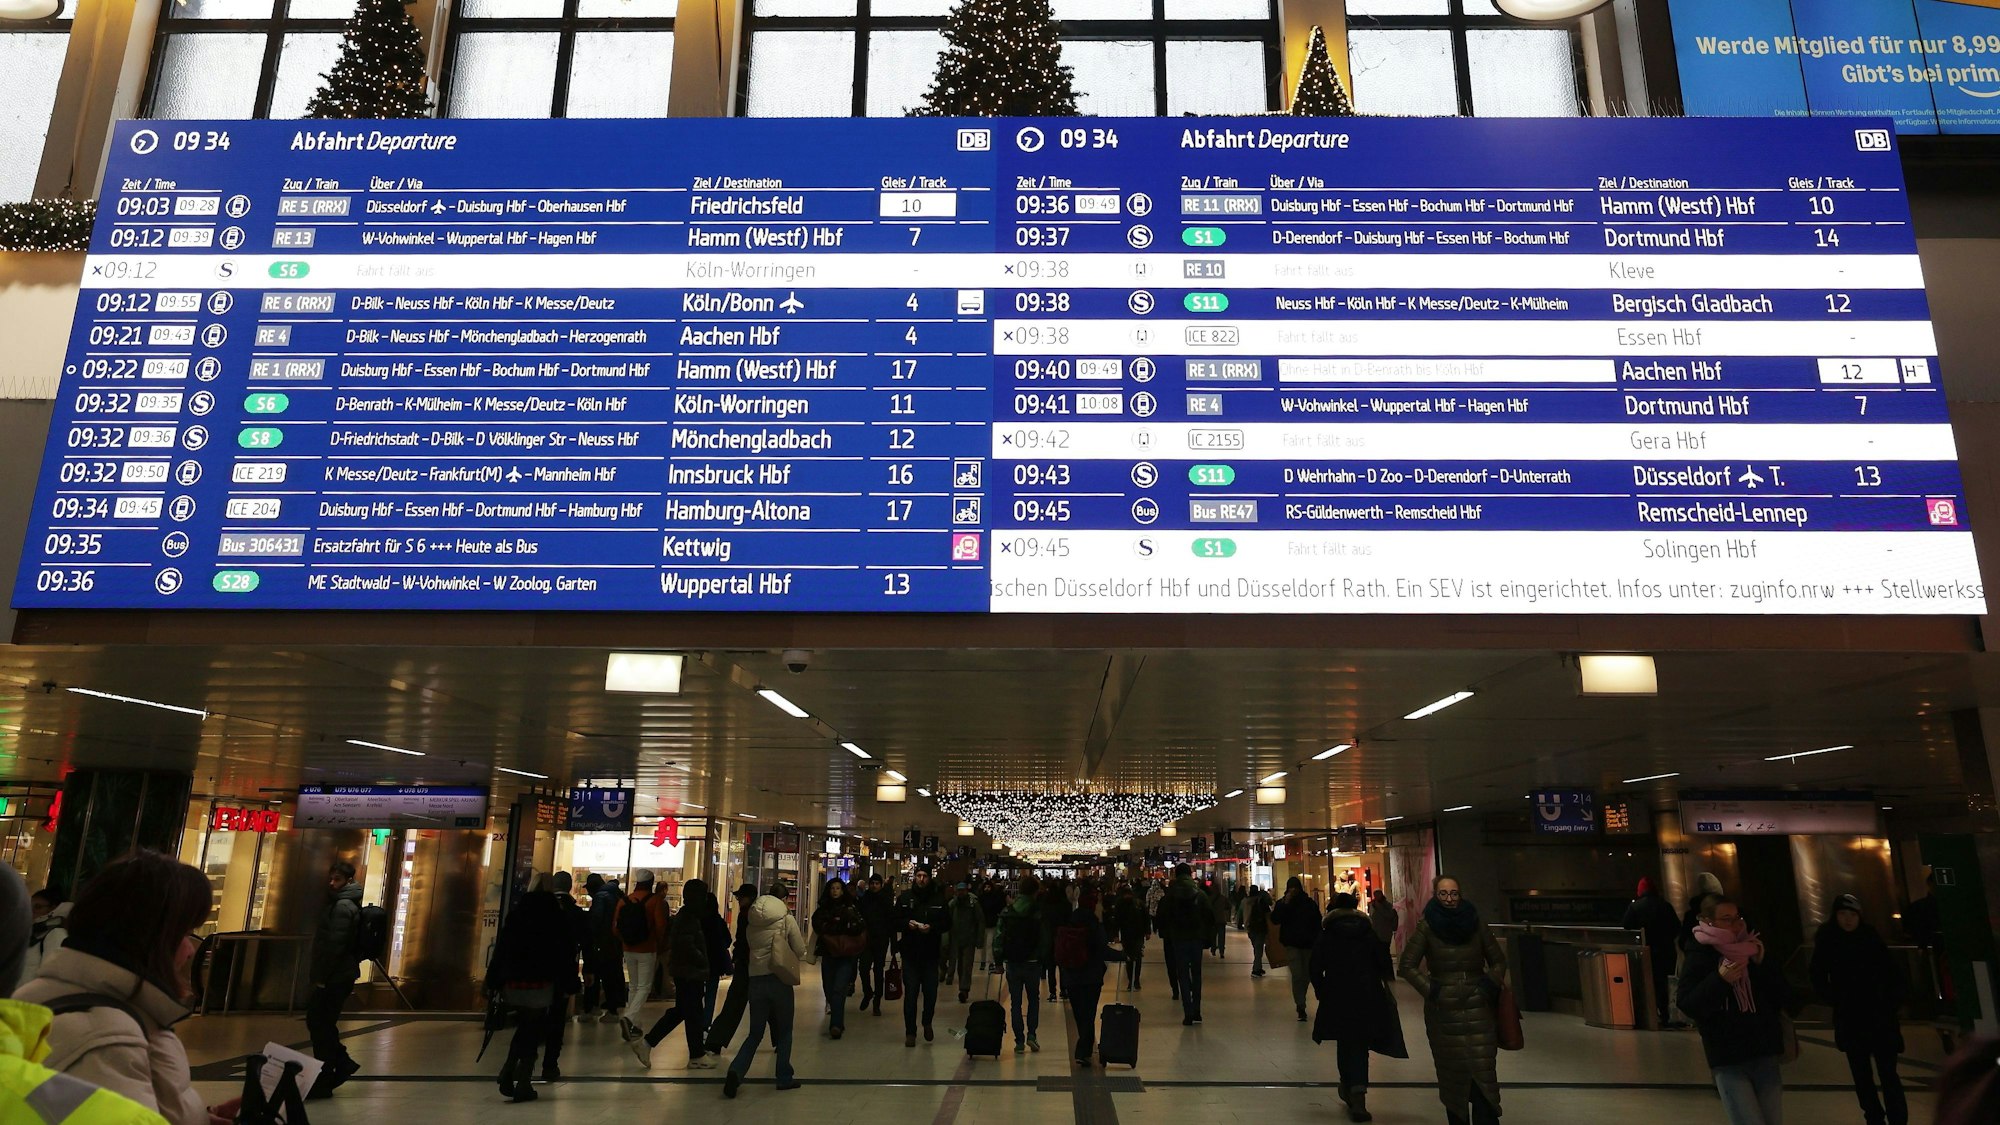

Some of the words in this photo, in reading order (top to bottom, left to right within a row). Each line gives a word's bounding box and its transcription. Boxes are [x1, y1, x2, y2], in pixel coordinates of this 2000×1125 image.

[1696, 36, 1769, 54] Werde
[1774, 36, 1865, 58] Mitglied
[1869, 36, 1903, 53] für
[1909, 40, 1947, 53] nur
[1952, 36, 2000, 56] 8,99
[1907, 64, 1943, 82] bei
[1947, 64, 2000, 86] prim
[174, 132, 200, 150] 09
[205, 132, 230, 150] 34
[291, 131, 364, 150] Abfahrt
[367, 131, 456, 154] Departure
[961, 133, 987, 147] DB
[1061, 129, 1086, 148] 09
[1093, 129, 1118, 148] 34
[1181, 129, 1255, 148] Abfahrt
[1258, 129, 1349, 153] Departure
[1859, 133, 1887, 148] DB
[122, 179, 140, 190] Zeit
[153, 179, 177, 190] Time
[283, 179, 303, 191] Zug
[313, 179, 339, 190] Train
[370, 177, 394, 190] Über
[407, 178, 423, 190] Via
[694, 177, 711, 188] Ziel
[724, 177, 782, 189] Destination
[882, 176, 906, 188] Gleis
[919, 177, 947, 189] Track
[117, 198, 170, 215] 09:03
[281, 200, 298, 213] RE
[299, 200, 309, 213] 5
[312, 199, 347, 215] (RRX)
[367, 200, 428, 212] Düsseldorf
[457, 200, 503, 215] Duisburg
[507, 200, 526, 212] Hbf
[538, 200, 602, 212] Oberhausen
[606, 200, 626, 212] Hbf
[691, 196, 803, 214] Friedrichsfeld
[901, 198, 922, 213] 10
[1017, 196, 1069, 213] 09:36
[1184, 198, 1200, 212] RE
[1203, 198, 1220, 212] 11
[1224, 197, 1259, 213] (RRX)
[1601, 197, 1653, 214] Hamm
[1658, 195, 1721, 217] (Westf)
[1726, 197, 1755, 214] Hbf
[1809, 197, 1834, 214] 10
[111, 229, 164, 247] 09:12
[689, 228, 740, 246] Hamm
[746, 226, 808, 249] (Westf)
[814, 228, 843, 246] Hbf
[909, 228, 921, 246] 7
[1017, 228, 1069, 246] 09:37
[1605, 228, 1690, 246] Dortmund
[1695, 229, 1724, 246] Hbf
[1815, 229, 1839, 246] 14
[104, 262, 158, 278] 09:12
[279, 263, 298, 277] S6
[687, 262, 814, 280] Köln-Worringen
[1016, 261, 1069, 277] 09:38
[1610, 262, 1654, 278] Kleve
[97, 293, 151, 312] 09:12
[683, 292, 774, 313] Köln/Bonn
[907, 293, 918, 311] 4
[1016, 293, 1069, 311] 09:38
[1193, 296, 1219, 309] S11
[1613, 294, 1687, 316] Bergisch
[1692, 294, 1773, 312] Gladbach
[1826, 294, 1851, 312] 12
[90, 326, 142, 345] 09:21
[680, 326, 744, 345] Aachen
[750, 326, 780, 345] Hbf
[906, 326, 917, 345] 4
[1016, 327, 1069, 344] 09:38
[1187, 330, 1206, 343] ICE
[1212, 327, 1237, 342] 822
[1618, 328, 1667, 345] Essen
[1673, 328, 1701, 345] Hbf
[83, 360, 137, 378] 09:22
[678, 360, 730, 379] Hamm
[736, 358, 800, 382] (Westf)
[806, 360, 836, 379] Hbf
[892, 360, 916, 379] 17
[1015, 360, 1069, 379] 09:40
[1623, 361, 1687, 380] Aachen
[1691, 361, 1721, 380] Hbf
[1842, 364, 1863, 379] 12
[76, 394, 131, 412] 09:32
[675, 394, 808, 418] Köln-Worringen
[891, 394, 915, 413] 11
[1015, 394, 1070, 414] 09:41
[1625, 396, 1714, 415] Dortmund
[1719, 396, 1749, 415] Hbf
[1855, 396, 1866, 415] 7
[68, 428, 124, 447] 09:32
[672, 429, 831, 452] Mönchengladbach
[890, 429, 914, 448] 12
[1014, 430, 1070, 448] 09:42
[1631, 431, 1670, 449] Gera
[1677, 432, 1706, 449] Hbf
[60, 463, 117, 482] 09:32
[236, 467, 254, 479] ICE
[259, 467, 283, 479] 219
[669, 464, 754, 484] Innsbruck
[760, 464, 790, 484] Hbf
[888, 464, 913, 484] 16
[1014, 465, 1070, 484] 09:43
[1634, 466, 1731, 485] Düsseldorf
[1769, 466, 1784, 486] T.
[1855, 466, 1881, 486] 13
[53, 498, 108, 518] 09:34
[666, 500, 810, 522] Hamburg-Altona
[887, 500, 912, 520] 17
[1014, 501, 1070, 521] 09:45
[1638, 502, 1807, 525] Remscheid-Lennep
[45, 534, 102, 554] 09:35
[222, 537, 246, 553] Bus
[248, 537, 299, 553] 306431
[663, 536, 730, 558] Kettwig
[1013, 538, 1070, 556] 09:45
[1644, 539, 1720, 562] Solingen
[1727, 539, 1756, 558] Hbf
[37, 571, 94, 591] 09:36
[661, 573, 753, 594] Wuppertal
[760, 573, 791, 594] Hbf
[885, 574, 909, 594] 13
[905, 832, 912, 843] 4
[925, 838, 932, 847] 5
